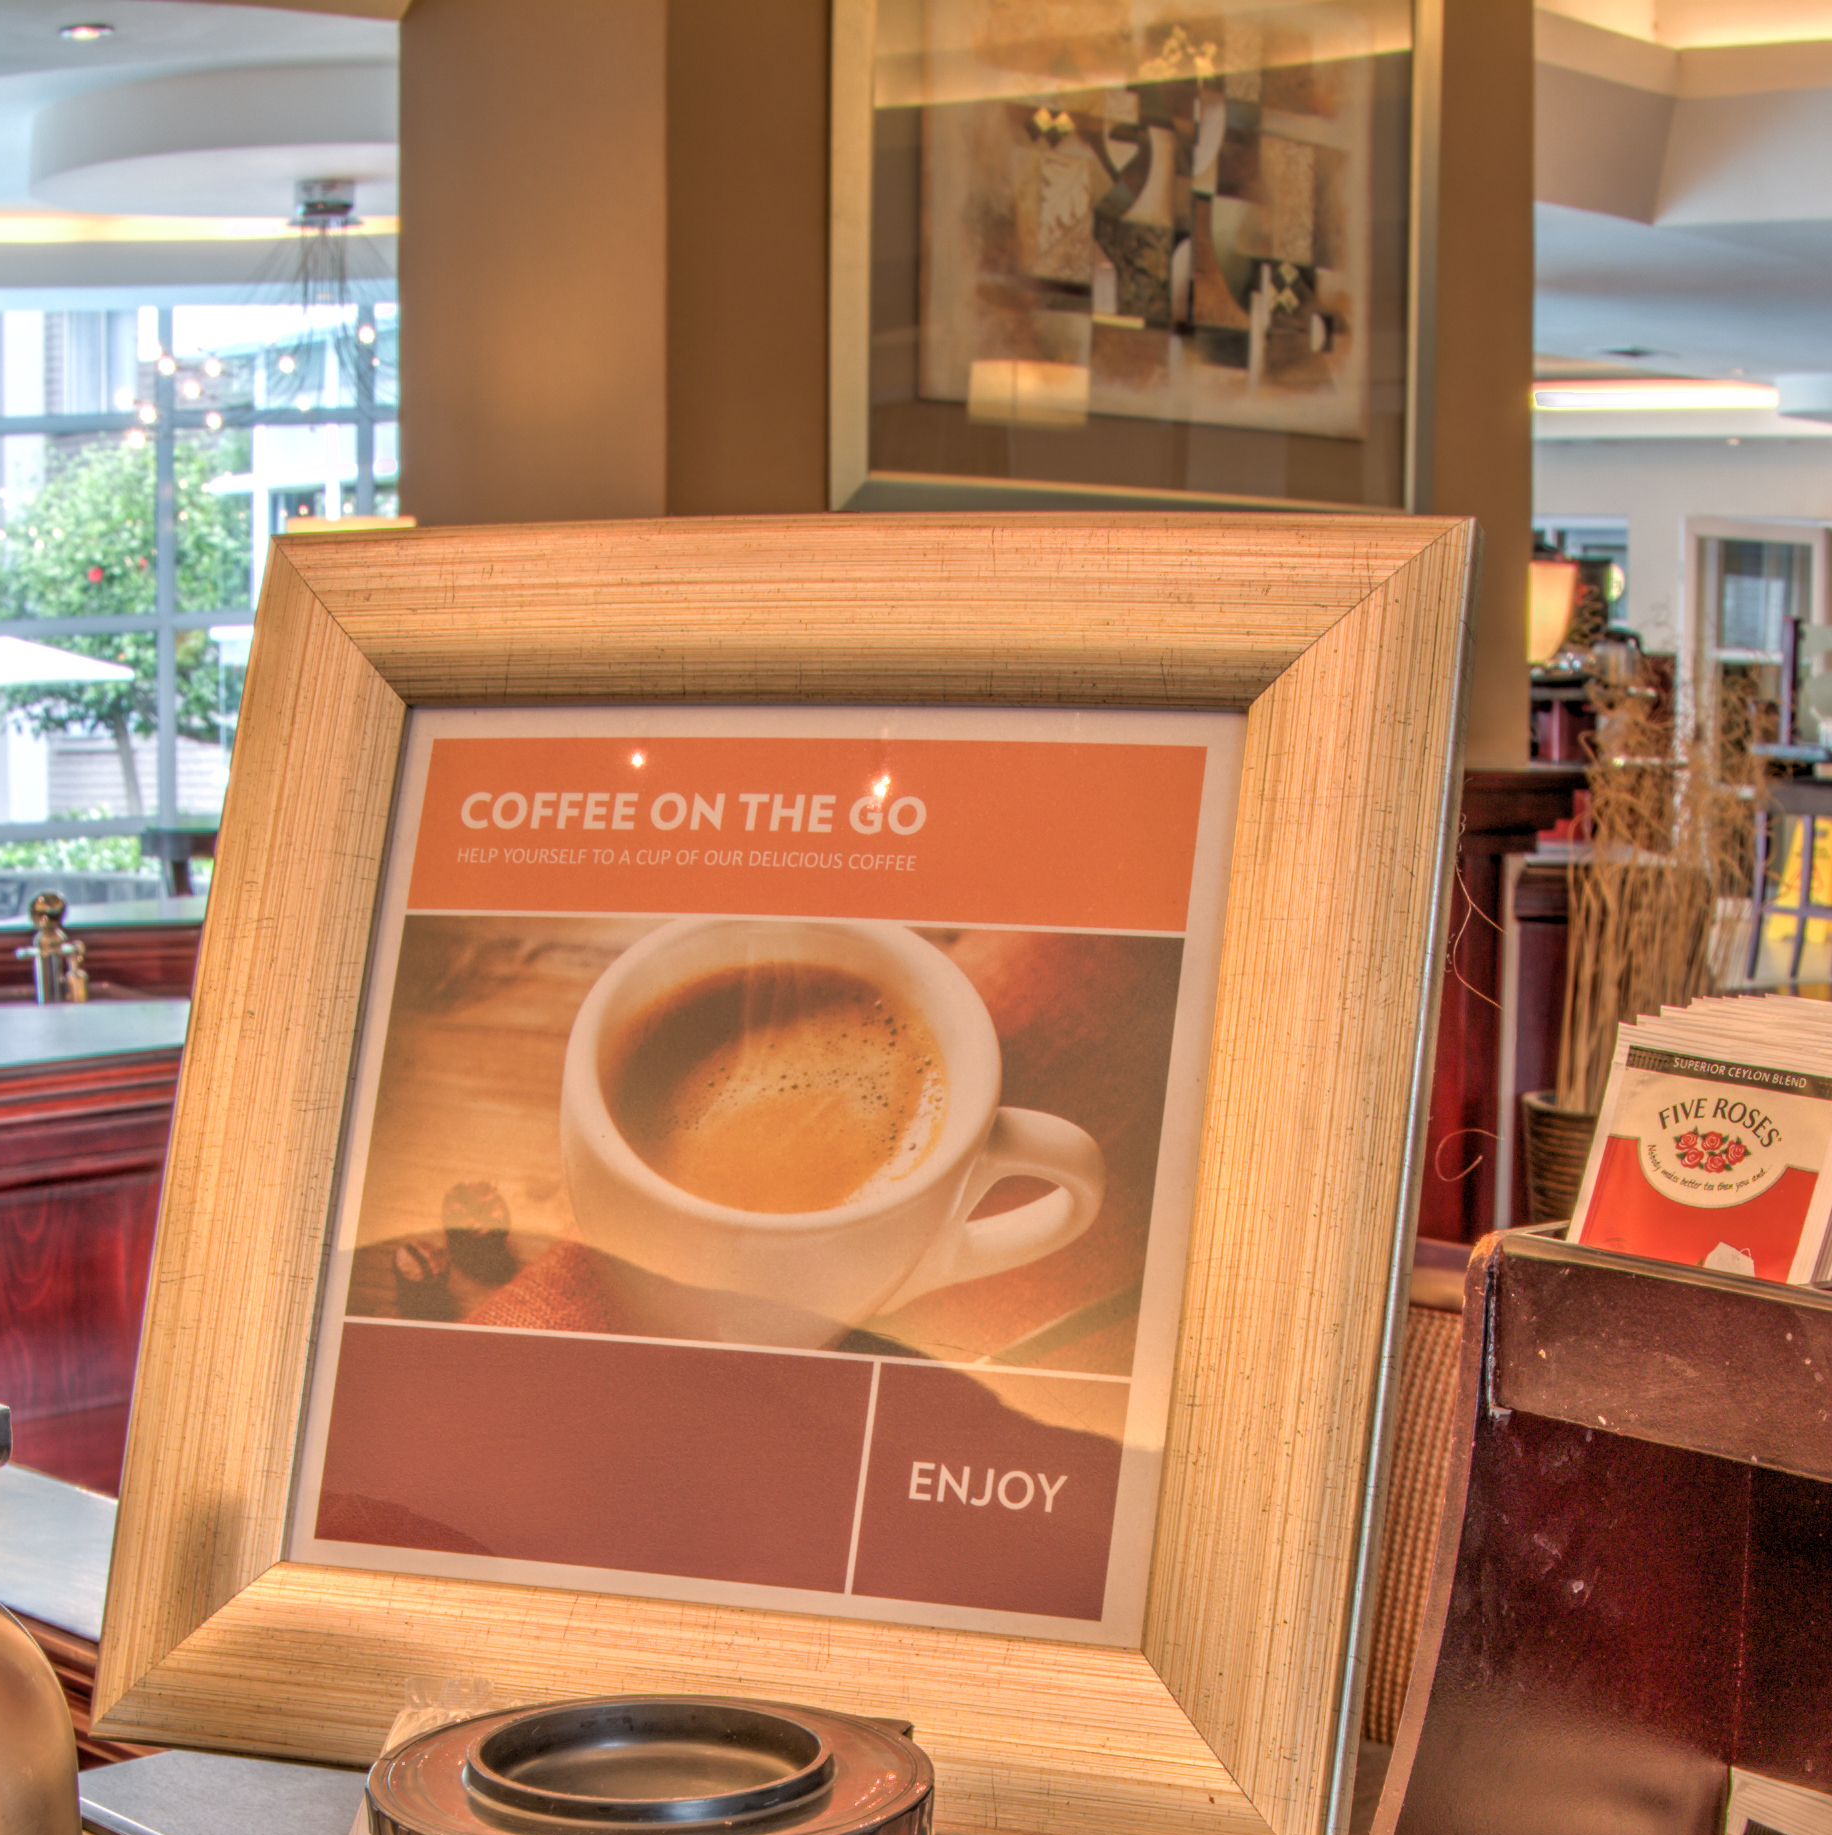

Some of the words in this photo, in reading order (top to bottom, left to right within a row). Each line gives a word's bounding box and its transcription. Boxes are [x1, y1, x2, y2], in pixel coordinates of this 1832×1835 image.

[460, 791, 639, 830] COFFEE
[650, 792, 726, 831] ON
[739, 793, 836, 833] THE
[849, 795, 927, 836] GO
[457, 848, 498, 864] HELP
[504, 848, 587, 865] YOURSELF
[592, 849, 614, 865] TO
[618, 849, 631, 865] A
[636, 849, 671, 866] CUP
[676, 850, 699, 866] OF
[704, 850, 743, 867] OUR
[748, 850, 843, 869] DELICIOUS
[848, 853, 917, 872] COFFEE
[1673, 1057, 1726, 1075] SUPERIOR
[1728, 1067, 1770, 1082] CEYLON
[1772, 1074, 1807, 1088] BLEND
[1658, 1098, 1707, 1130] FIVE
[1712, 1098, 1780, 1148] ROSES
[908, 1461, 1068, 1513] ENJOY
